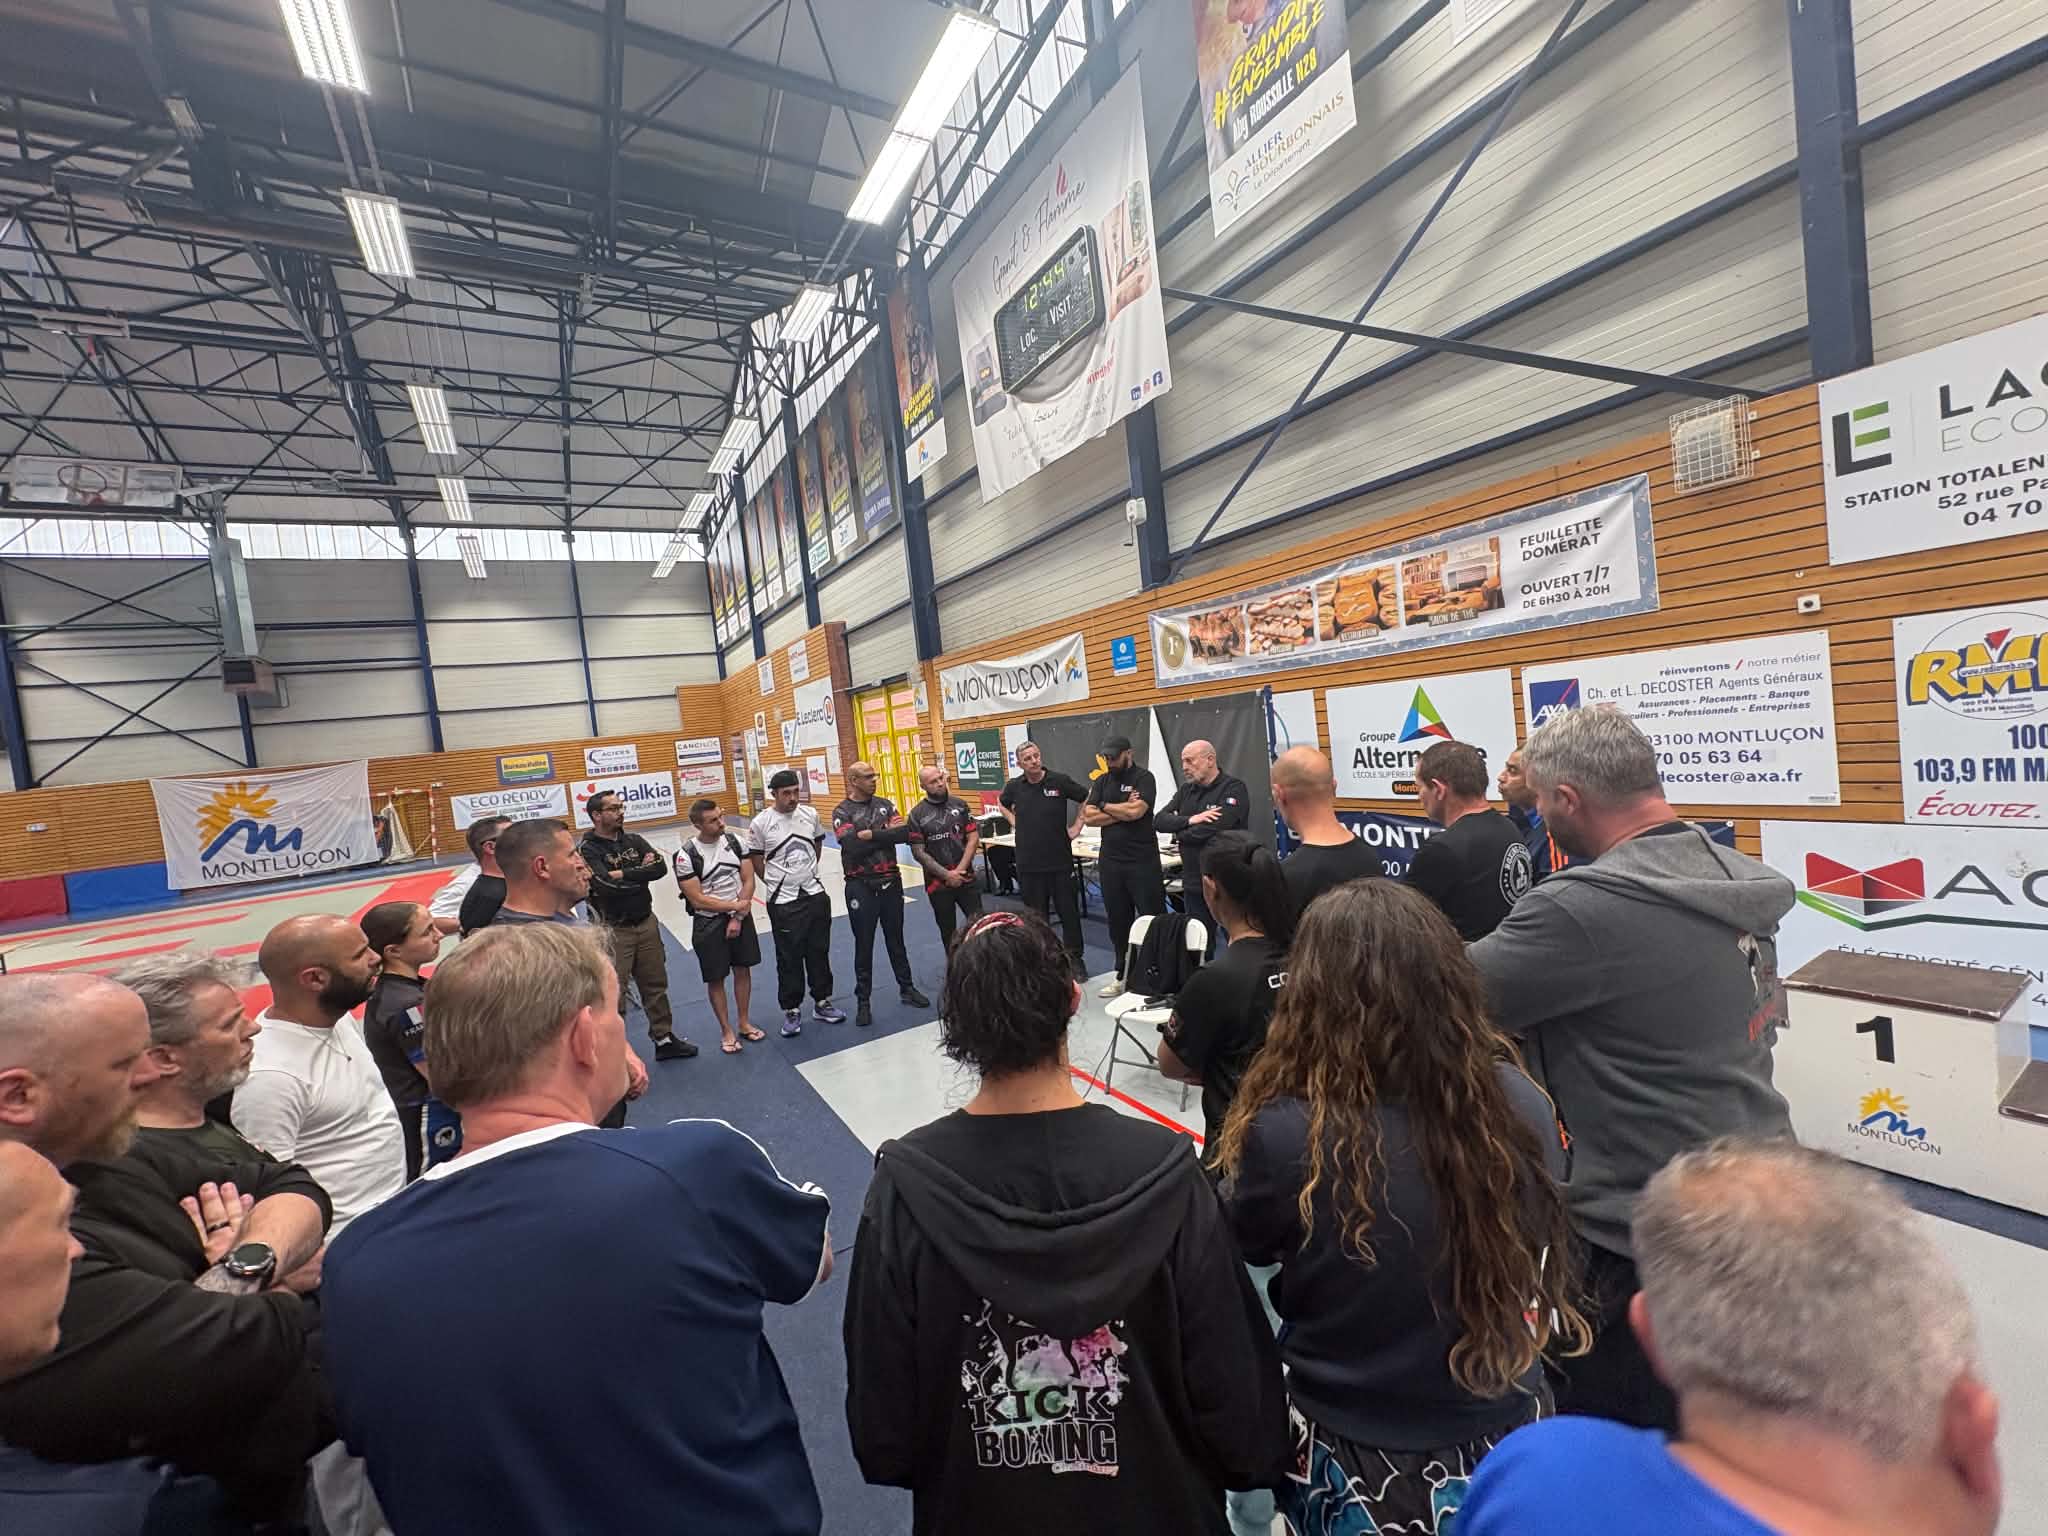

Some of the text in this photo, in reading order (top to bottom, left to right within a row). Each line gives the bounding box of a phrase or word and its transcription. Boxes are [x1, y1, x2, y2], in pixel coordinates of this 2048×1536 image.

[1231, 0, 1325, 113] ENSEMBLE
[1252, 91, 1345, 177] BOURBONNAIS
[1244, 130, 1284, 171] ALLIER
[1844, 453, 2048, 510] STATION TOTALEN
[1937, 492, 1967, 510] 52
[1976, 486, 2014, 503] rue
[1963, 499, 2042, 527] 04 70
[1520, 517, 1603, 549] FEUILLETTE
[1522, 533, 1601, 561] DOMÉRAT
[1520, 564, 1610, 595] OUVERT 7/7
[1523, 584, 1610, 609] DE 6H30 À 20H
[1659, 662, 1731, 677] réinventons
[1747, 656, 1778, 669] notre
[1781, 652, 1822, 665] métier
[956, 658, 1060, 705] MONTLUÇON
[1587, 686, 1607, 700] Ch.
[1610, 686, 1622, 698] et
[1641, 677, 1714, 696] DECOSTER
[1719, 676, 1760, 690] Agents
[1763, 671, 1823, 686] Généraux
[1638, 698, 1690, 709] Assurances
[1699, 692, 1757, 704] Placements
[1768, 688, 1810, 701] Banque
[1667, 706, 1738, 719] Professionnels
[1749, 701, 1811, 713] Entreprises
[1359, 732, 1396, 743] Groupe
[1699, 726, 1824, 745] MONTLUÇON
[978, 750, 1001, 760] CENTRE
[978, 760, 1002, 769] FRANCE
[1679, 751, 1702, 765] 05
[1708, 750, 1731, 764] 63
[1738, 749, 1763, 763] 64
[1914, 757, 1976, 785] 103,9
[1983, 757, 2016, 782] FM
[470, 794, 499, 808] ECO
[616, 782, 672, 802] dalkia
[1918, 790, 2038, 818] ÉCOUTEZ
[201, 846, 351, 881] MONTLUÇON
[1856, 1016, 1895, 1064] 1
[1847, 1122, 1942, 1156] MONTLUÇON
[968, 1384, 1116, 1432] KICK
[974, 1421, 1118, 1469] BOXING
